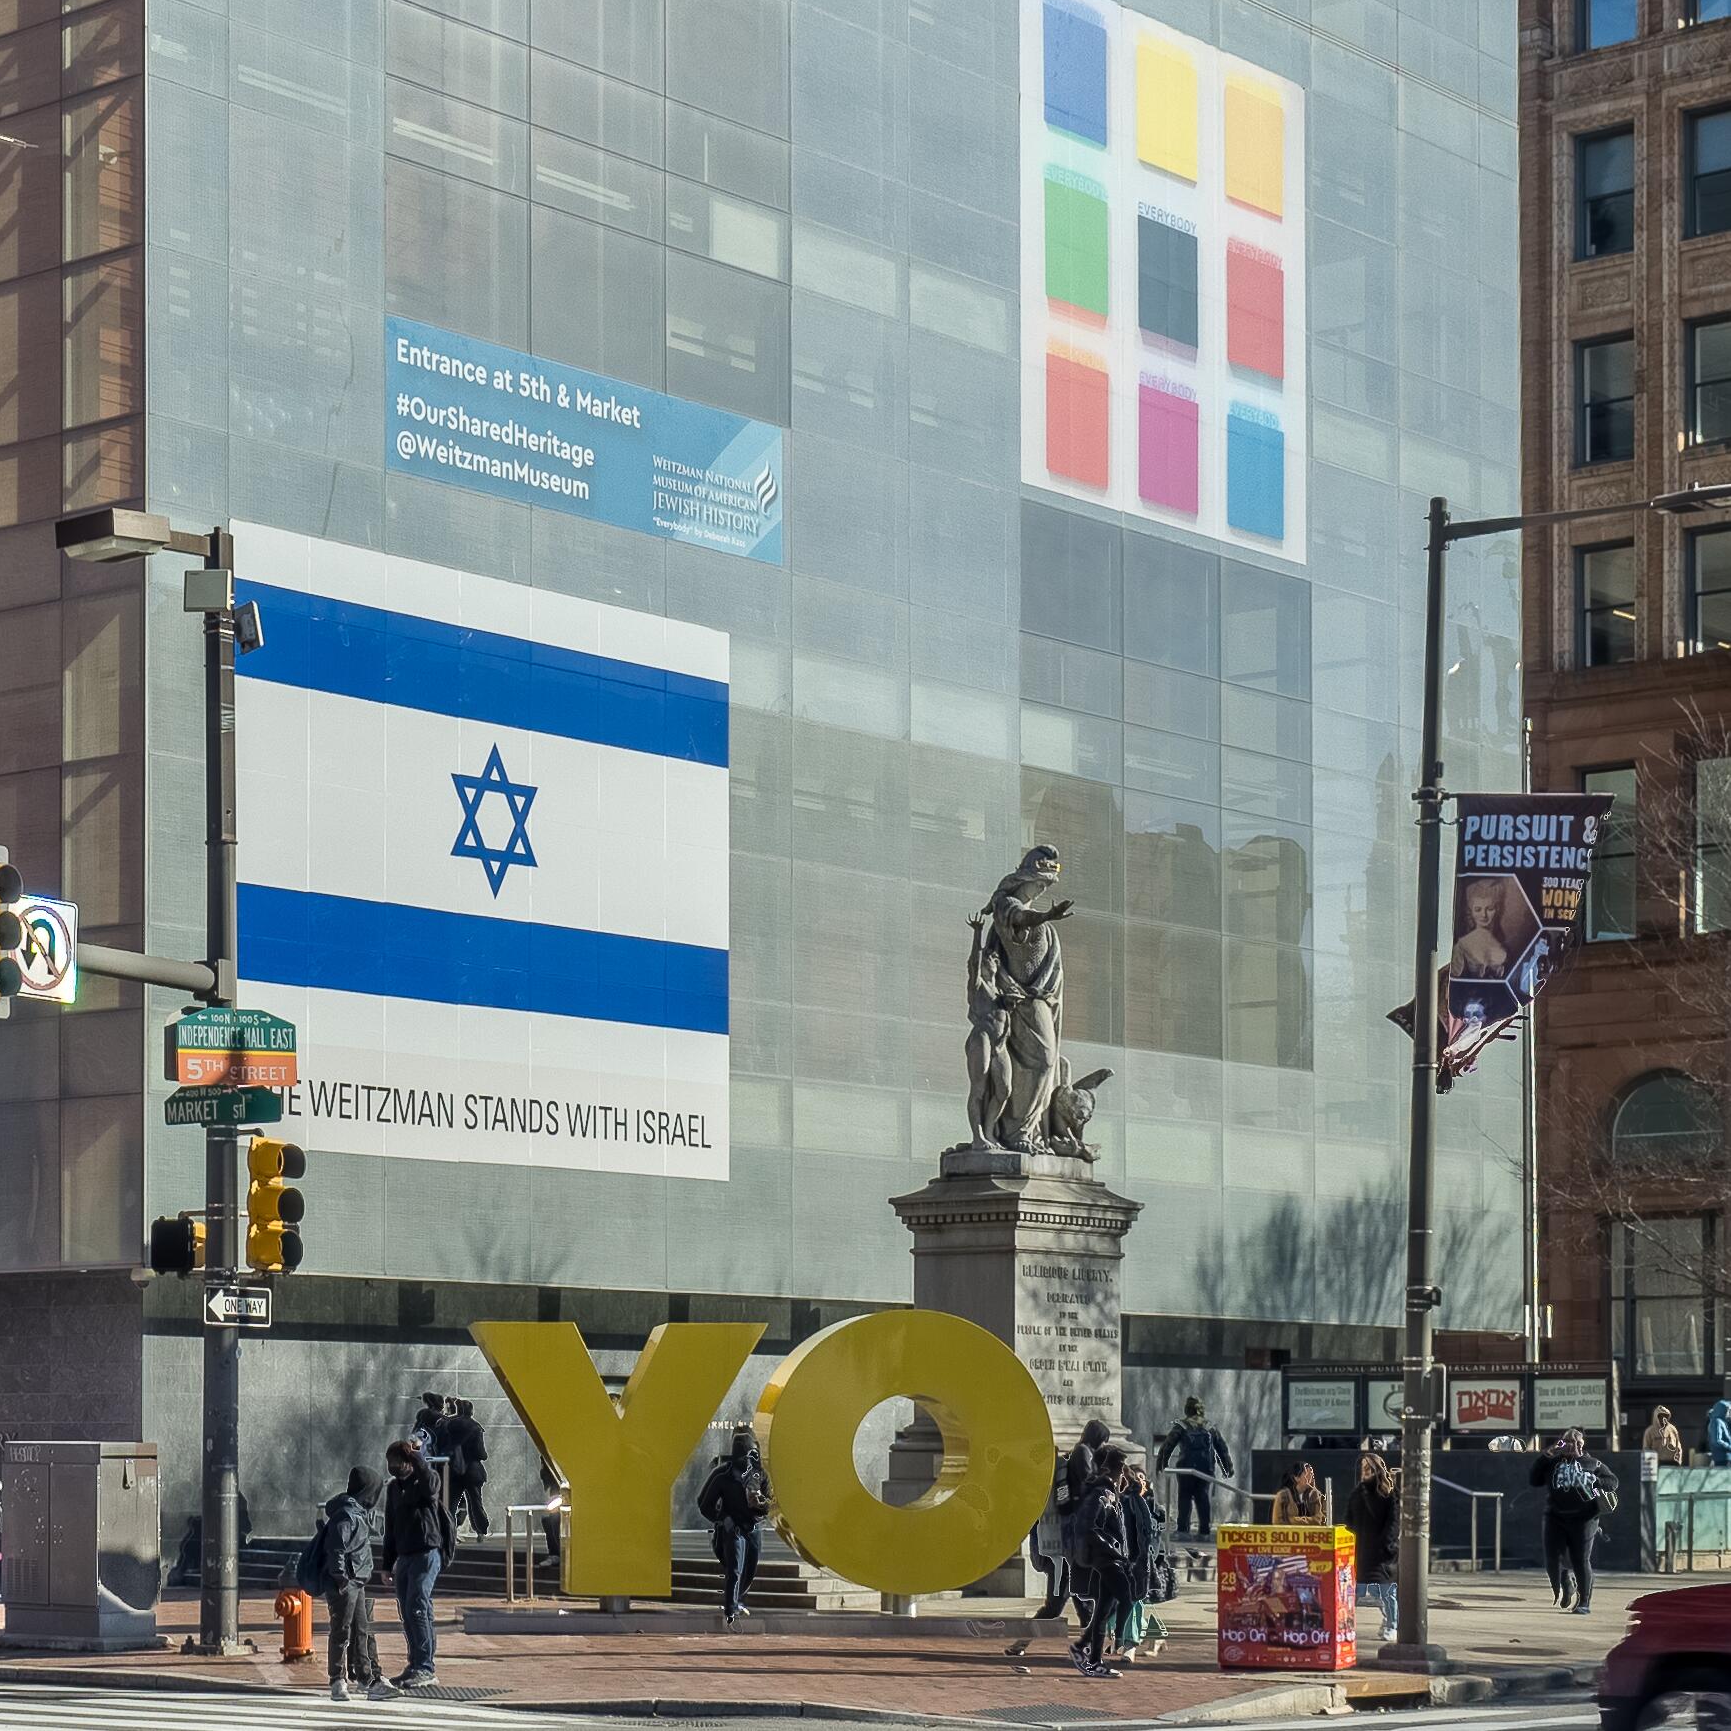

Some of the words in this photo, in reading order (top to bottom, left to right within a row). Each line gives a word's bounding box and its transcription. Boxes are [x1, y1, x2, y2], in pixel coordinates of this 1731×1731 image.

[1137, 201, 1197, 234] EVERYBODY
[1227, 238, 1283, 269] EVERYBODY
[396, 337, 487, 385] Entrance
[492, 368, 513, 393] at
[518, 372, 551, 403] 5th
[556, 383, 570, 409] &
[576, 388, 641, 429] Market
[1139, 371, 1197, 401] EVERYBODY
[396, 392, 595, 468] #OurSharedHeritage
[396, 430, 590, 500] @WeitzmanMuseum
[652, 454, 703, 480] WEITZMAN
[704, 470, 752, 492] NATIONAL
[652, 474, 693, 495] MUSEUM
[694, 484, 707, 499] OF
[708, 494, 757, 512] AMERICAN
[652, 490, 700, 518] JEWISH
[703, 504, 759, 534] HISTORY
[1464, 814, 1574, 842] PURSUIT
[1582, 815, 1597, 844] &
[1464, 844, 1591, 871] PERSISTENC
[178, 1024, 241, 1048] INDEPENDENCE
[270, 1028, 293, 1049] EAST
[186, 1058, 223, 1080] 5TH
[230, 1065, 287, 1080] STREET
[167, 1099, 219, 1124] MARKET
[309, 1080, 453, 1129] WEITZMAN
[463, 1093, 559, 1136] STANDS
[565, 1102, 628, 1142] WITH
[636, 1108, 712, 1149] ISRAEL
[224, 1298, 242, 1313] ONE
[244, 1299, 264, 1314] WAY
[1491, 1364, 1529, 1372] JEWISH
[1534, 1364, 1580, 1372] HISTORY
[470, 1310, 1056, 1597] YO
[1221, 1531, 1267, 1543] TICKETS
[1271, 1531, 1300, 1543] SOLD
[1303, 1531, 1333, 1543] HERE
[1221, 1572, 1236, 1585] 28
[1222, 1629, 1246, 1642] Hop
[1249, 1628, 1266, 1642] On
[1283, 1631, 1308, 1645] Hop
[1311, 1630, 1330, 1644] Off
